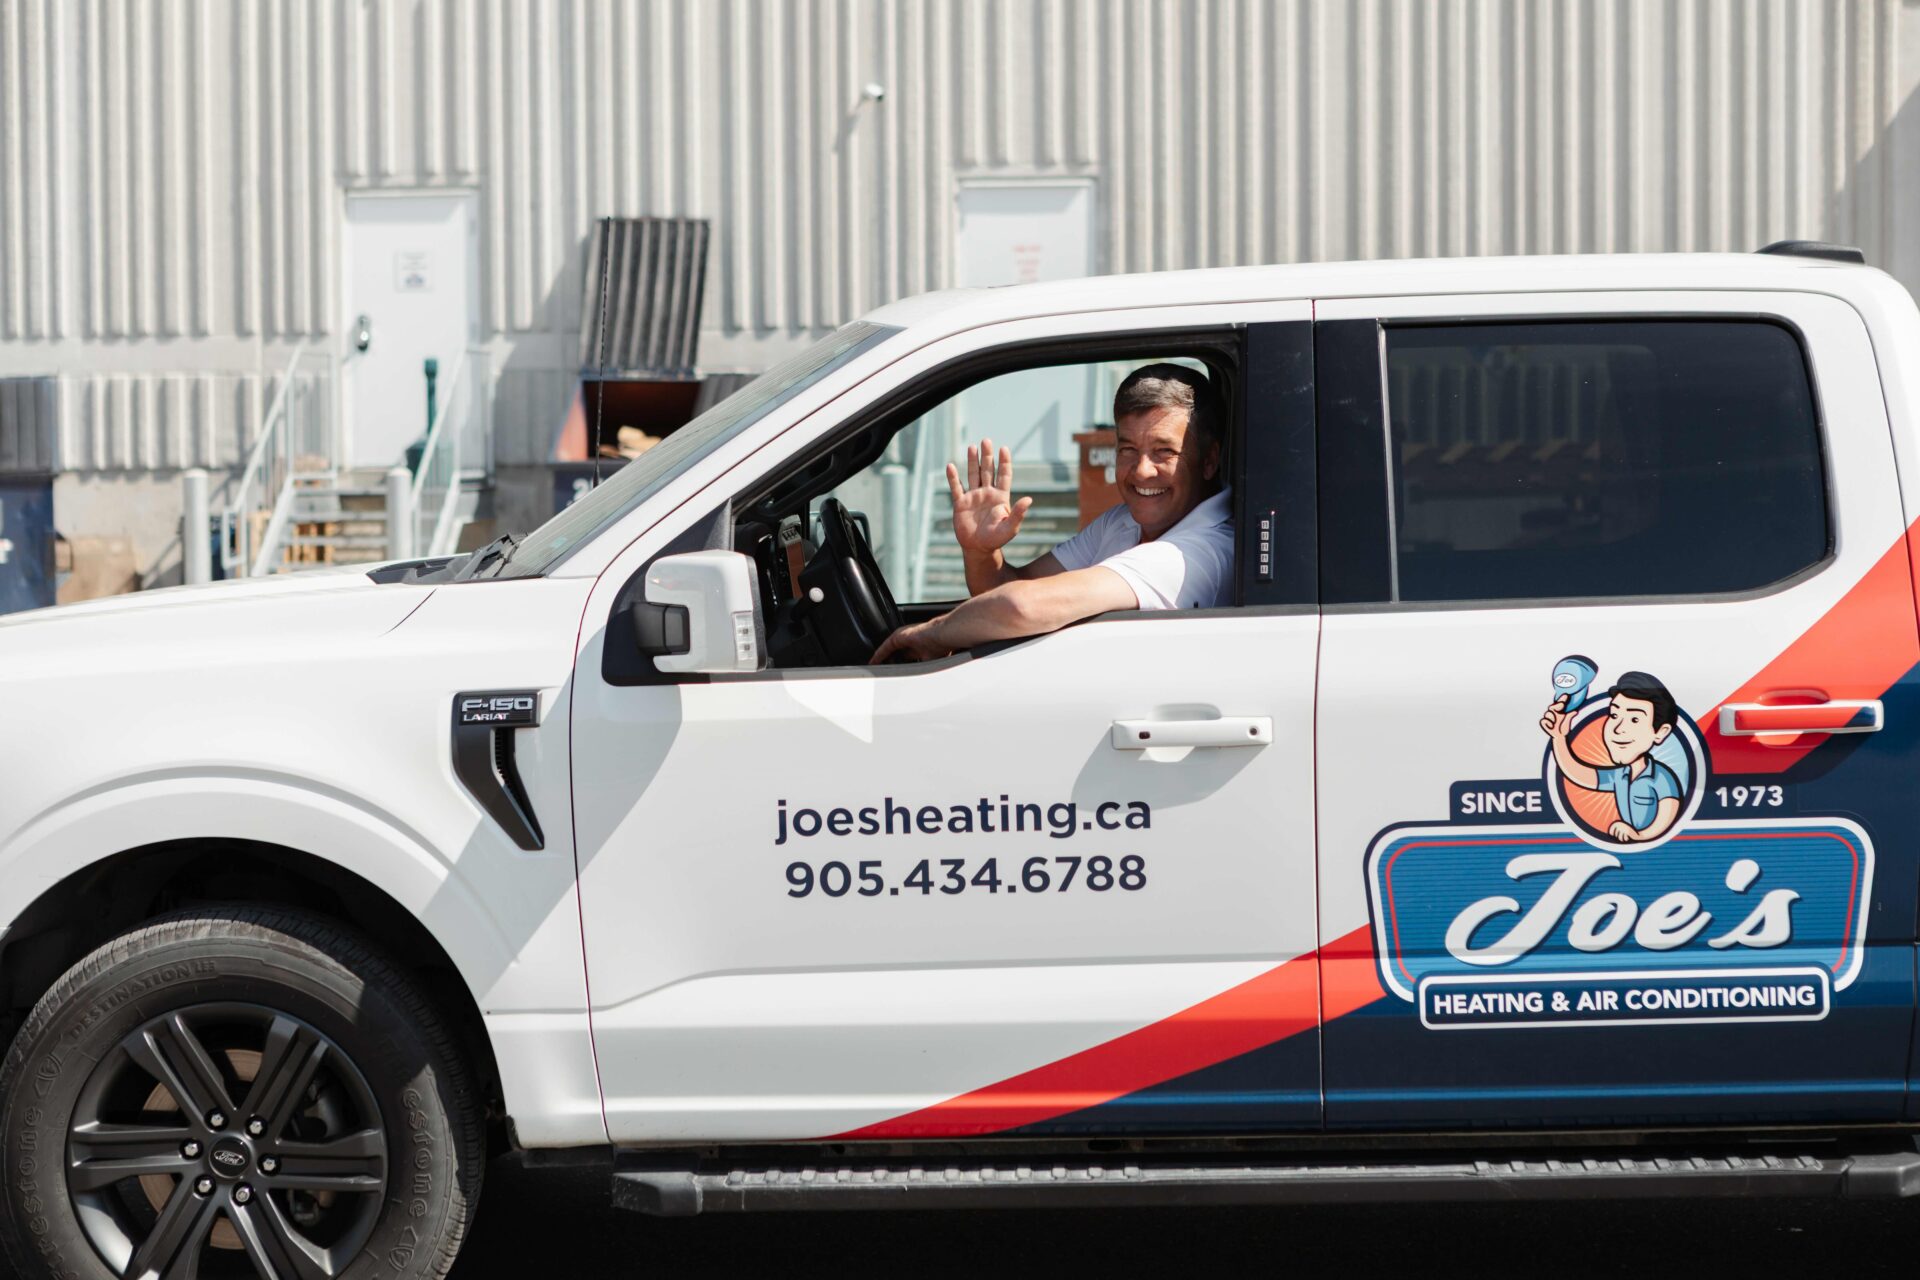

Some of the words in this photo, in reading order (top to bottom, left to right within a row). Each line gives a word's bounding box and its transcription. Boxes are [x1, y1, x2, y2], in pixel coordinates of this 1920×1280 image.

[462, 697, 533, 712] F-150
[463, 713, 510, 722] LARIAT
[1461, 791, 1543, 814] SINCE
[1715, 785, 1783, 808] 1973
[775, 794, 1152, 846] joesheating.ca
[785, 854, 1148, 899] 905.434.6788
[1444, 852, 1801, 966] Joe's
[70, 965, 191, 1040] DESTINATION
[1434, 992, 1544, 1015] HEATING
[1551, 991, 1571, 1012] &
[1576, 990, 1619, 1012] AIR
[1624, 985, 1817, 1011] CONDITIONING
[216, 1152, 241, 1165] Ford
